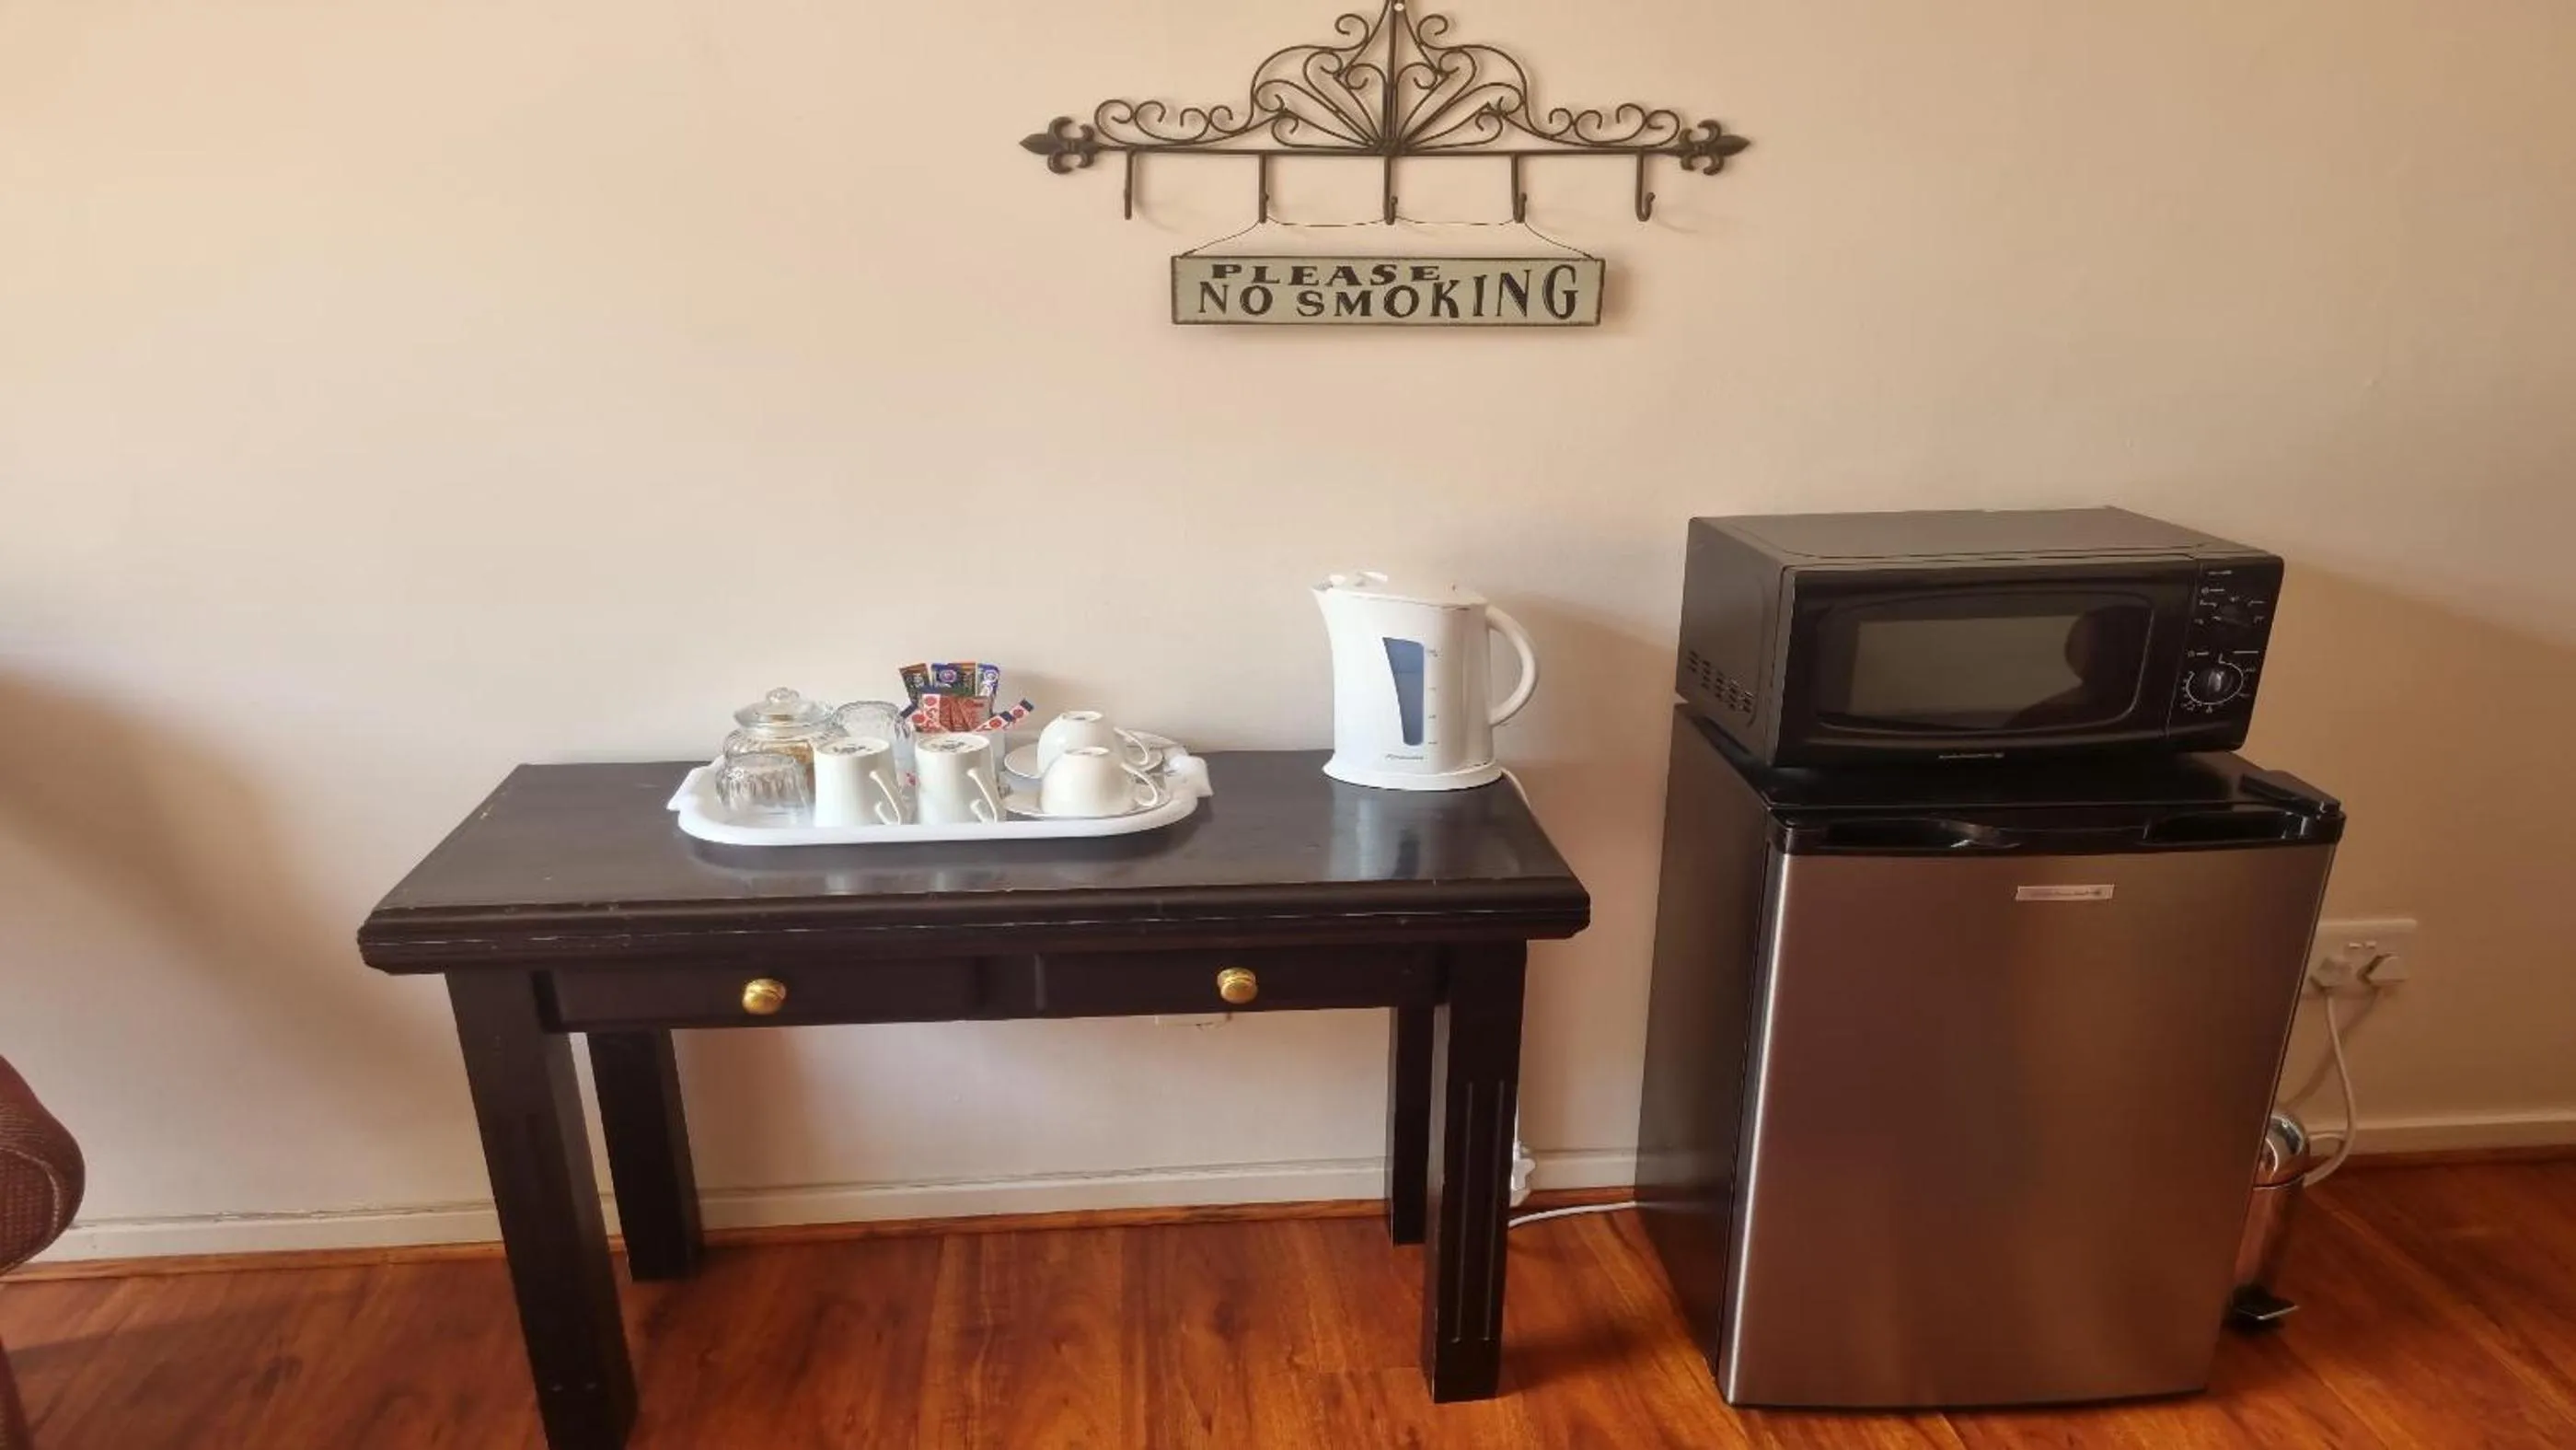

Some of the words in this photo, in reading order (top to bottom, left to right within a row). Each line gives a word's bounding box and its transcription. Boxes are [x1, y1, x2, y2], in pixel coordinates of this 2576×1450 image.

[1198, 280, 1274, 317] NO
[1296, 264, 1579, 320] SMOKING
[1211, 263, 1441, 286] PLEASE
